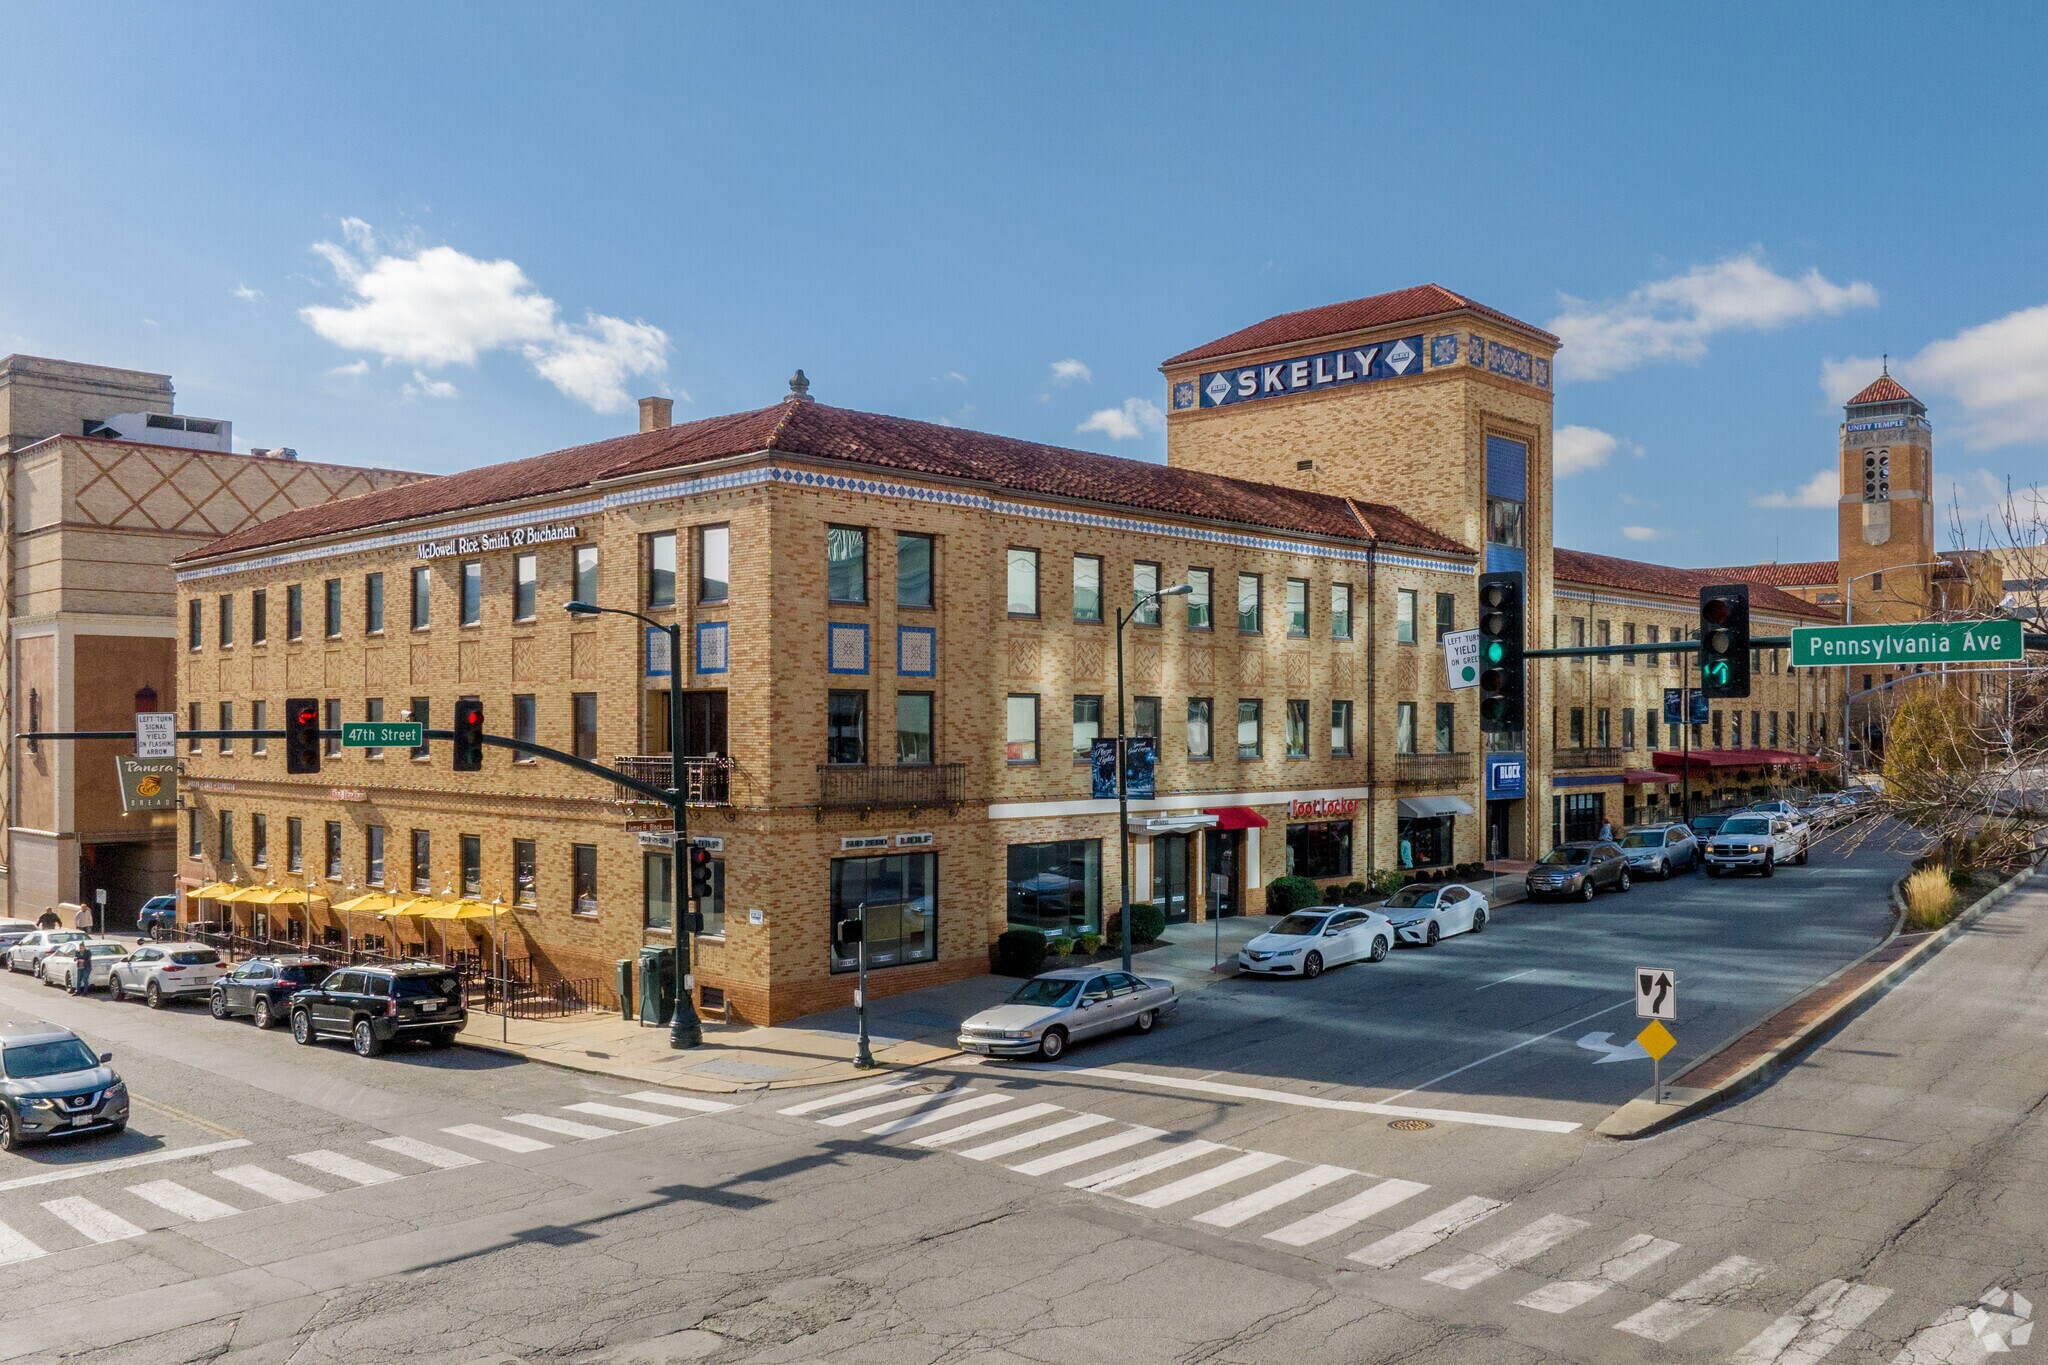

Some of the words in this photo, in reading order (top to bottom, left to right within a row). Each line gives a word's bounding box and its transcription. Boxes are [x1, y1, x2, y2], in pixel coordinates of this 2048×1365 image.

[1238, 347, 1379, 397] SKELLY
[1847, 423, 1872, 431] UNITY
[1872, 420, 1904, 429] TEMPLE
[416, 539, 457, 559] McDowell,
[458, 537, 480, 554] Rice,
[481, 533, 510, 551] Smith
[512, 528, 525, 546] &
[527, 525, 576, 544] Buchanan
[1447, 636, 1462, 646] LEFT
[1810, 632, 1950, 660] Pennsylvania
[1963, 631, 2001, 652] Ave
[1454, 644, 1477, 656] YIELD
[1450, 659, 1460, 667] ON
[1463, 655, 1480, 665] GREE
[348, 728, 375, 741] 47th
[381, 728, 416, 741] Street
[124, 761, 174, 773] Panera
[1500, 765, 1520, 779] BLOCK
[1292, 799, 1318, 817] Foot
[1322, 796, 1359, 815] Locker
